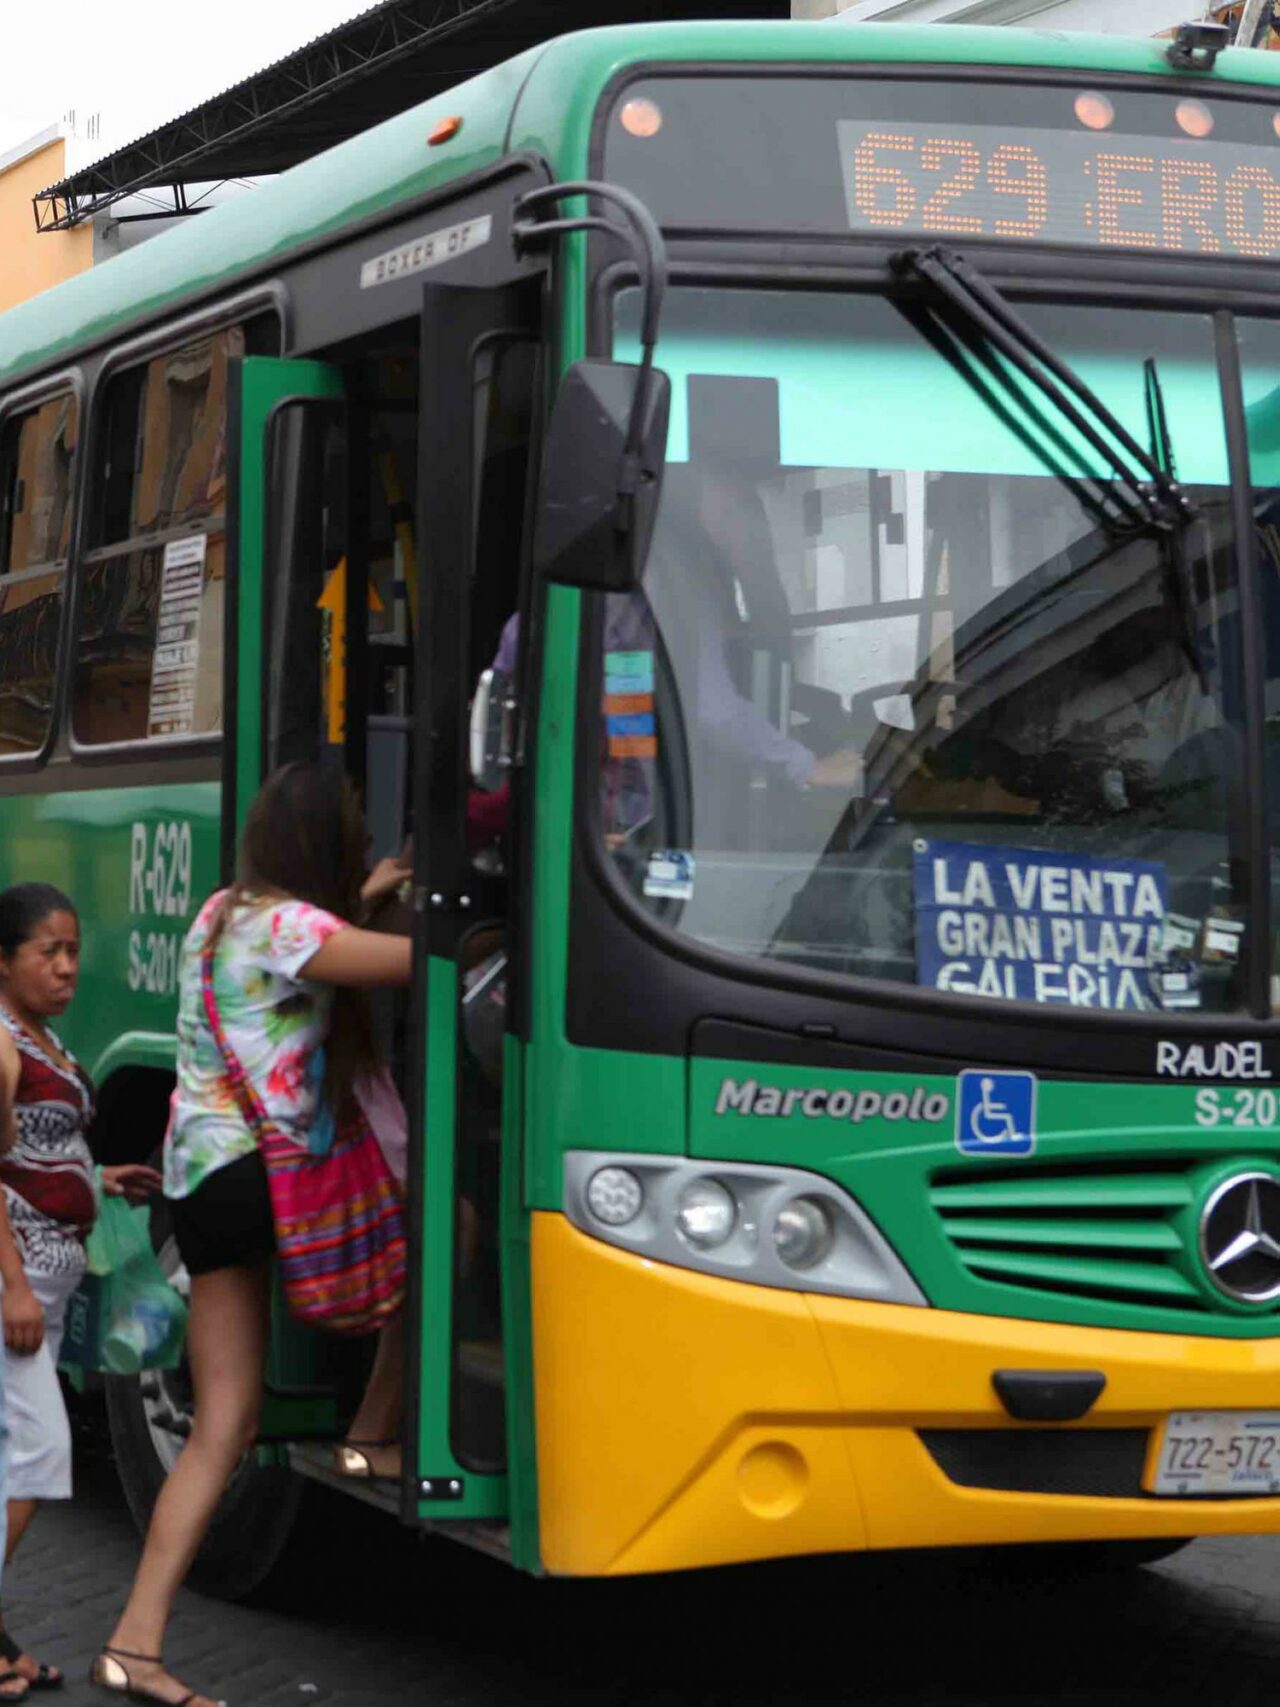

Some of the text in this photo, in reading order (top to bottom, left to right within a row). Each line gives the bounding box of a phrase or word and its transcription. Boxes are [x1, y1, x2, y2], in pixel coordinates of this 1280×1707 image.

[854, 131, 1048, 238] 629
[376, 241, 434, 279] BOXER
[129, 820, 192, 917] R-629
[934, 858, 1166, 919] LA VENTA
[936, 909, 1042, 961] GRAN
[1156, 1041, 1273, 1079] RAUDEL
[715, 1079, 950, 1123] Marcopolo
[1195, 1087, 1280, 1127] S-20
